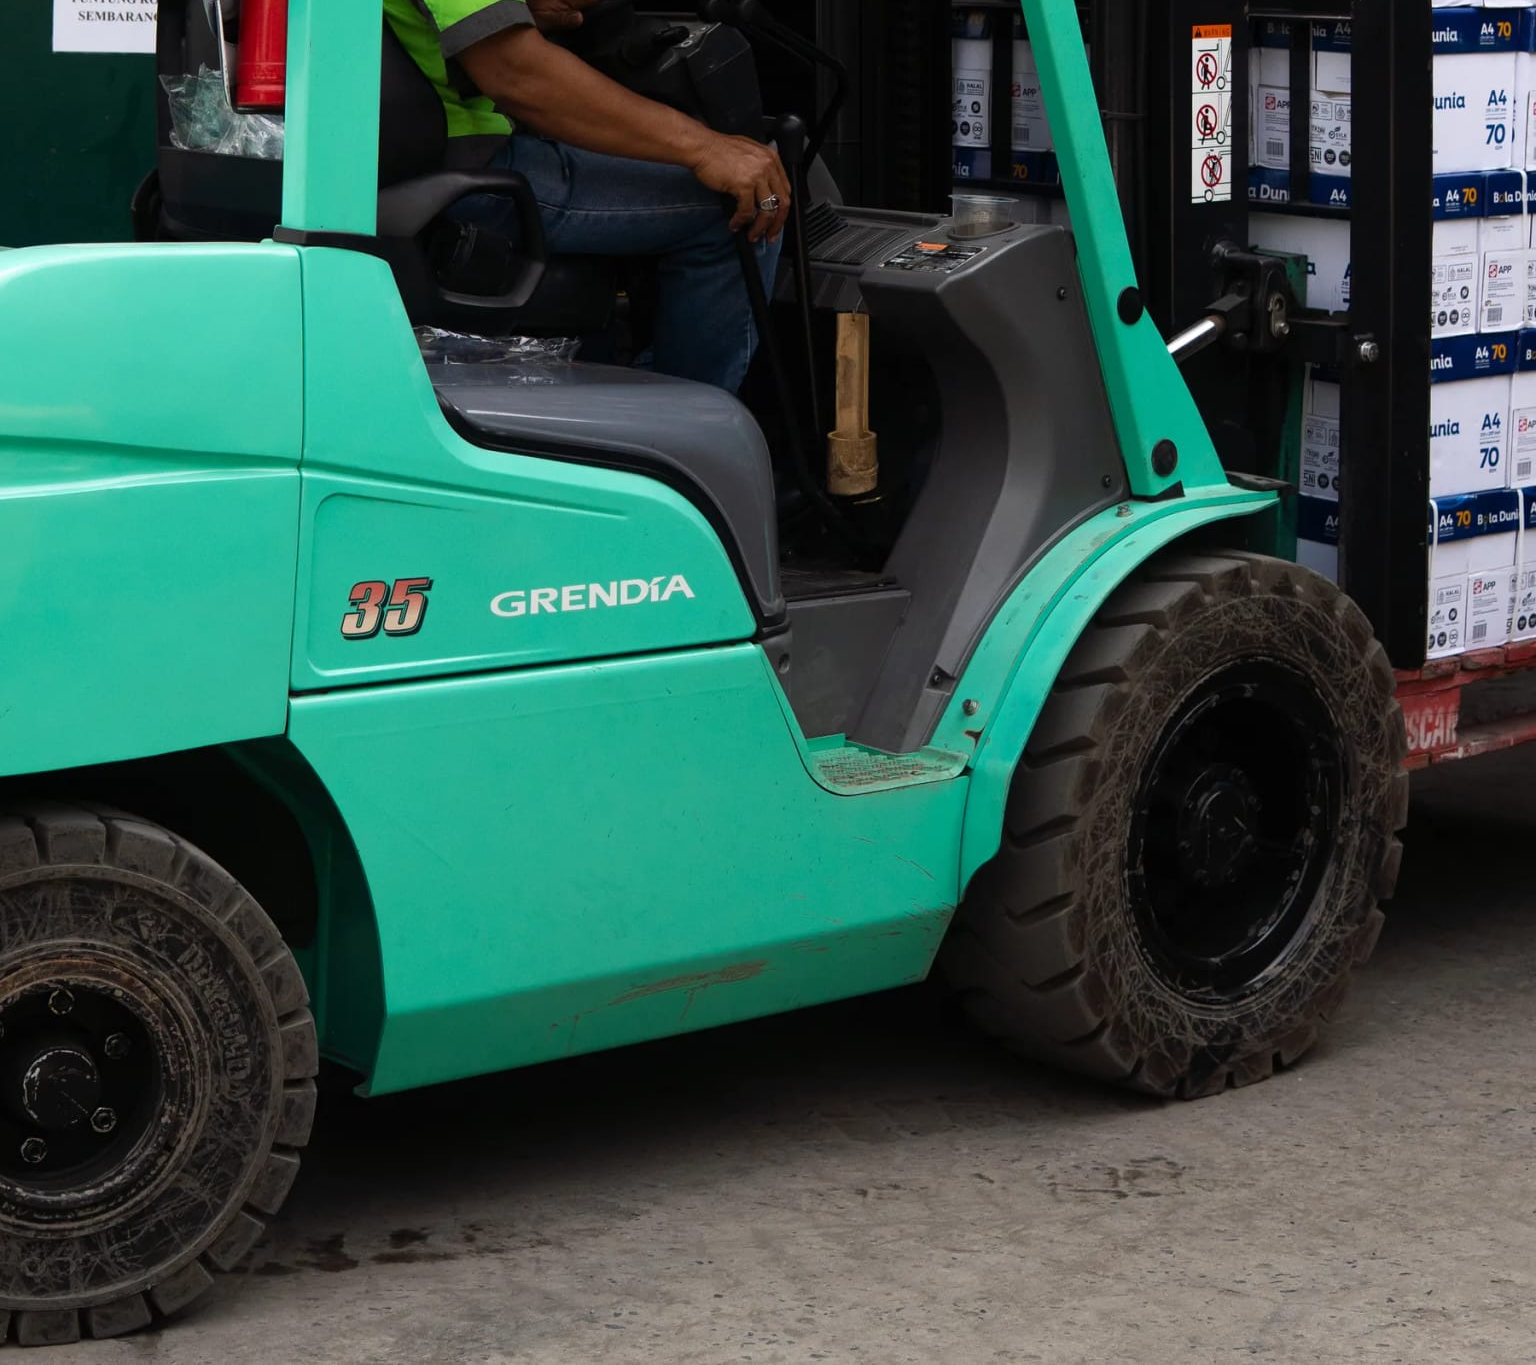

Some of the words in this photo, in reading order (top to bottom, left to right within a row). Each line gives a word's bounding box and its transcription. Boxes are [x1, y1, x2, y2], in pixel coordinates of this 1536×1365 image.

[1432, 27, 1458, 42] unia
[1481, 22, 1495, 35] A4
[1497, 21, 1511, 37] 70
[1435, 92, 1465, 110] unia
[1488, 89, 1507, 106] A4
[1486, 124, 1505, 145] 70
[1013, 164, 1028, 179] 70
[1330, 188, 1347, 202] A4
[1445, 189, 1460, 202] A4
[1463, 187, 1477, 202] 70
[1493, 191, 1513, 203] Bola
[1498, 265, 1512, 274] APP
[1475, 346, 1489, 359] A4
[1491, 344, 1507, 360] 70
[1430, 419, 1460, 438] unia
[1481, 413, 1501, 431] A4
[1480, 447, 1500, 469] 70
[1439, 514, 1453, 527] A4
[1456, 510, 1471, 527] 70
[1500, 509, 1520, 523] Duni
[1482, 580, 1496, 591] APP
[341, 577, 433, 640] 35
[1404, 704, 1458, 750] SCAR
